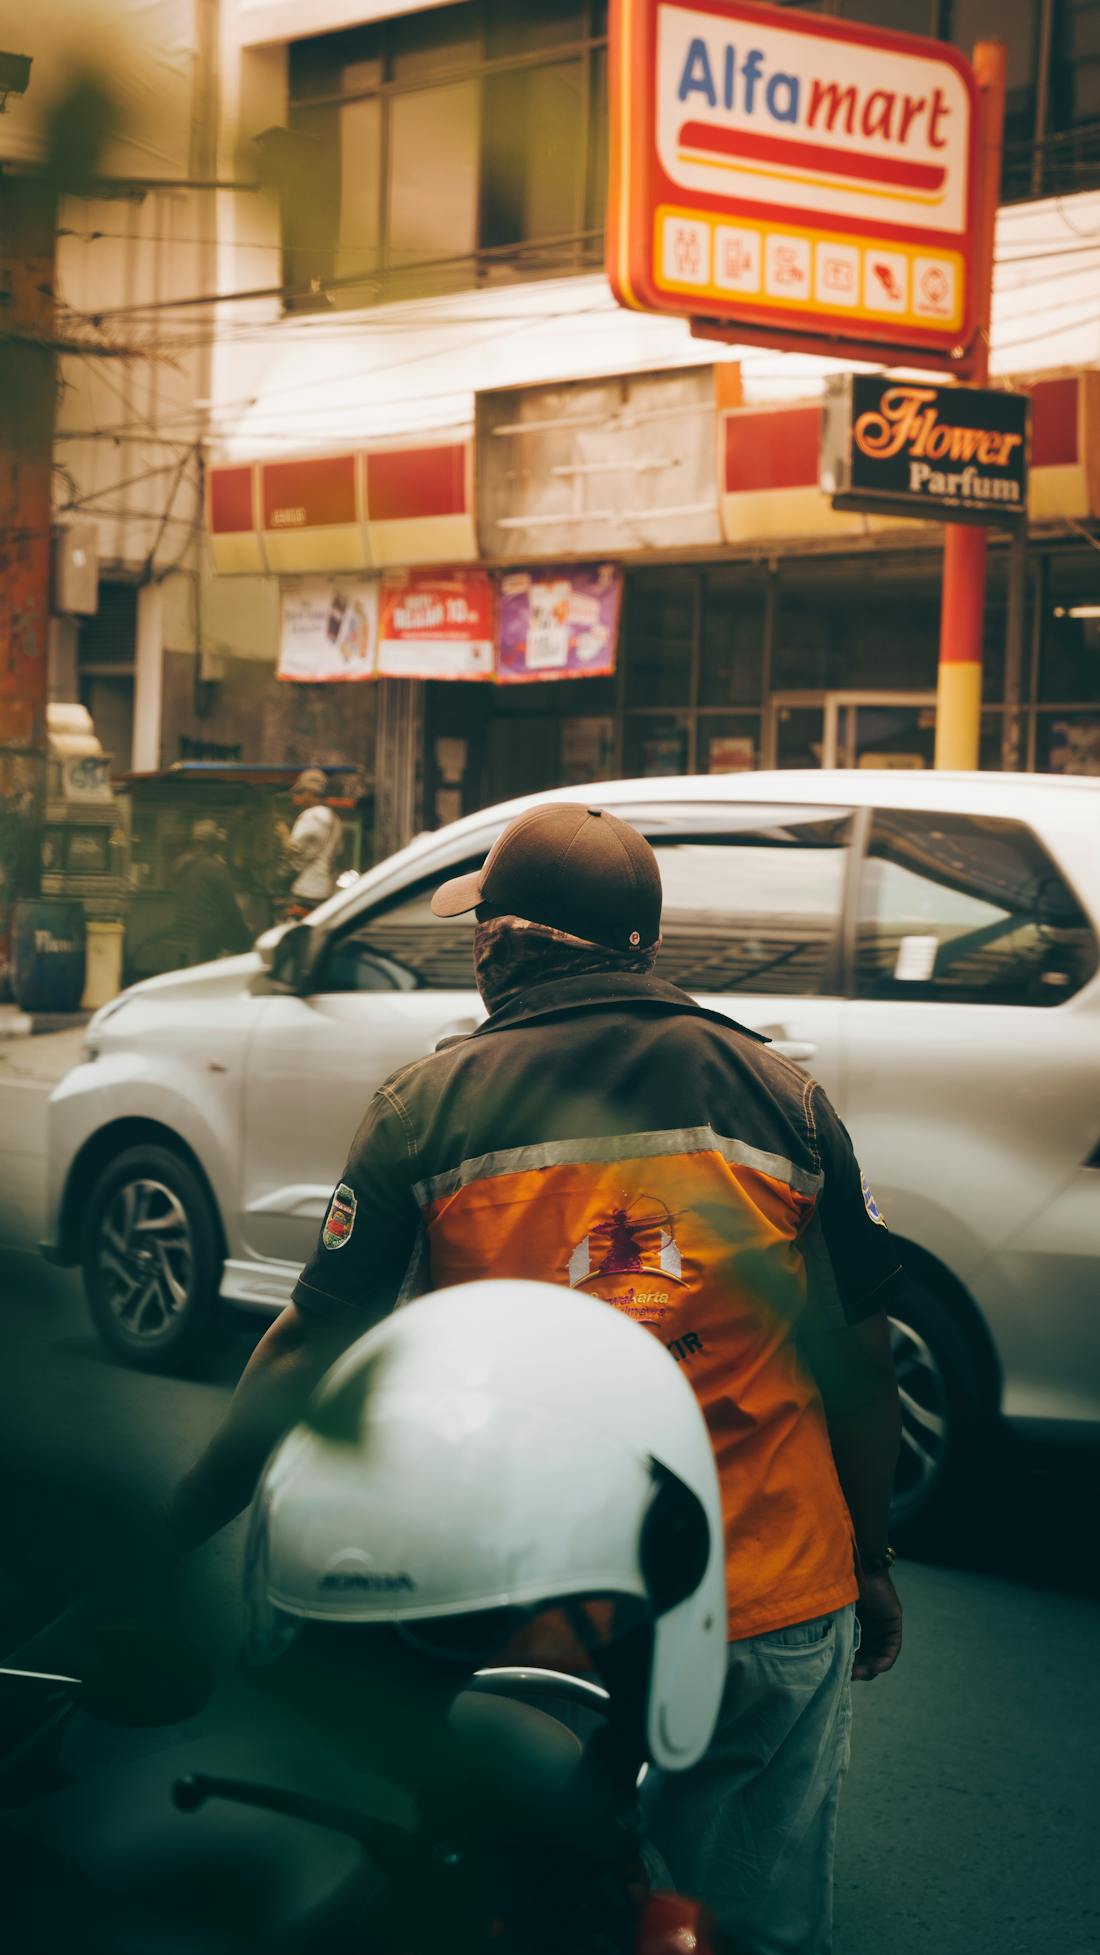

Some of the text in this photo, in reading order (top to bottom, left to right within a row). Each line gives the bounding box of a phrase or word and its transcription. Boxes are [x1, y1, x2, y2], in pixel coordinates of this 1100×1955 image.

[677, 37, 950, 149] Alfamart
[855, 386, 1022, 466] Flower
[909, 461, 1020, 501] Parfum
